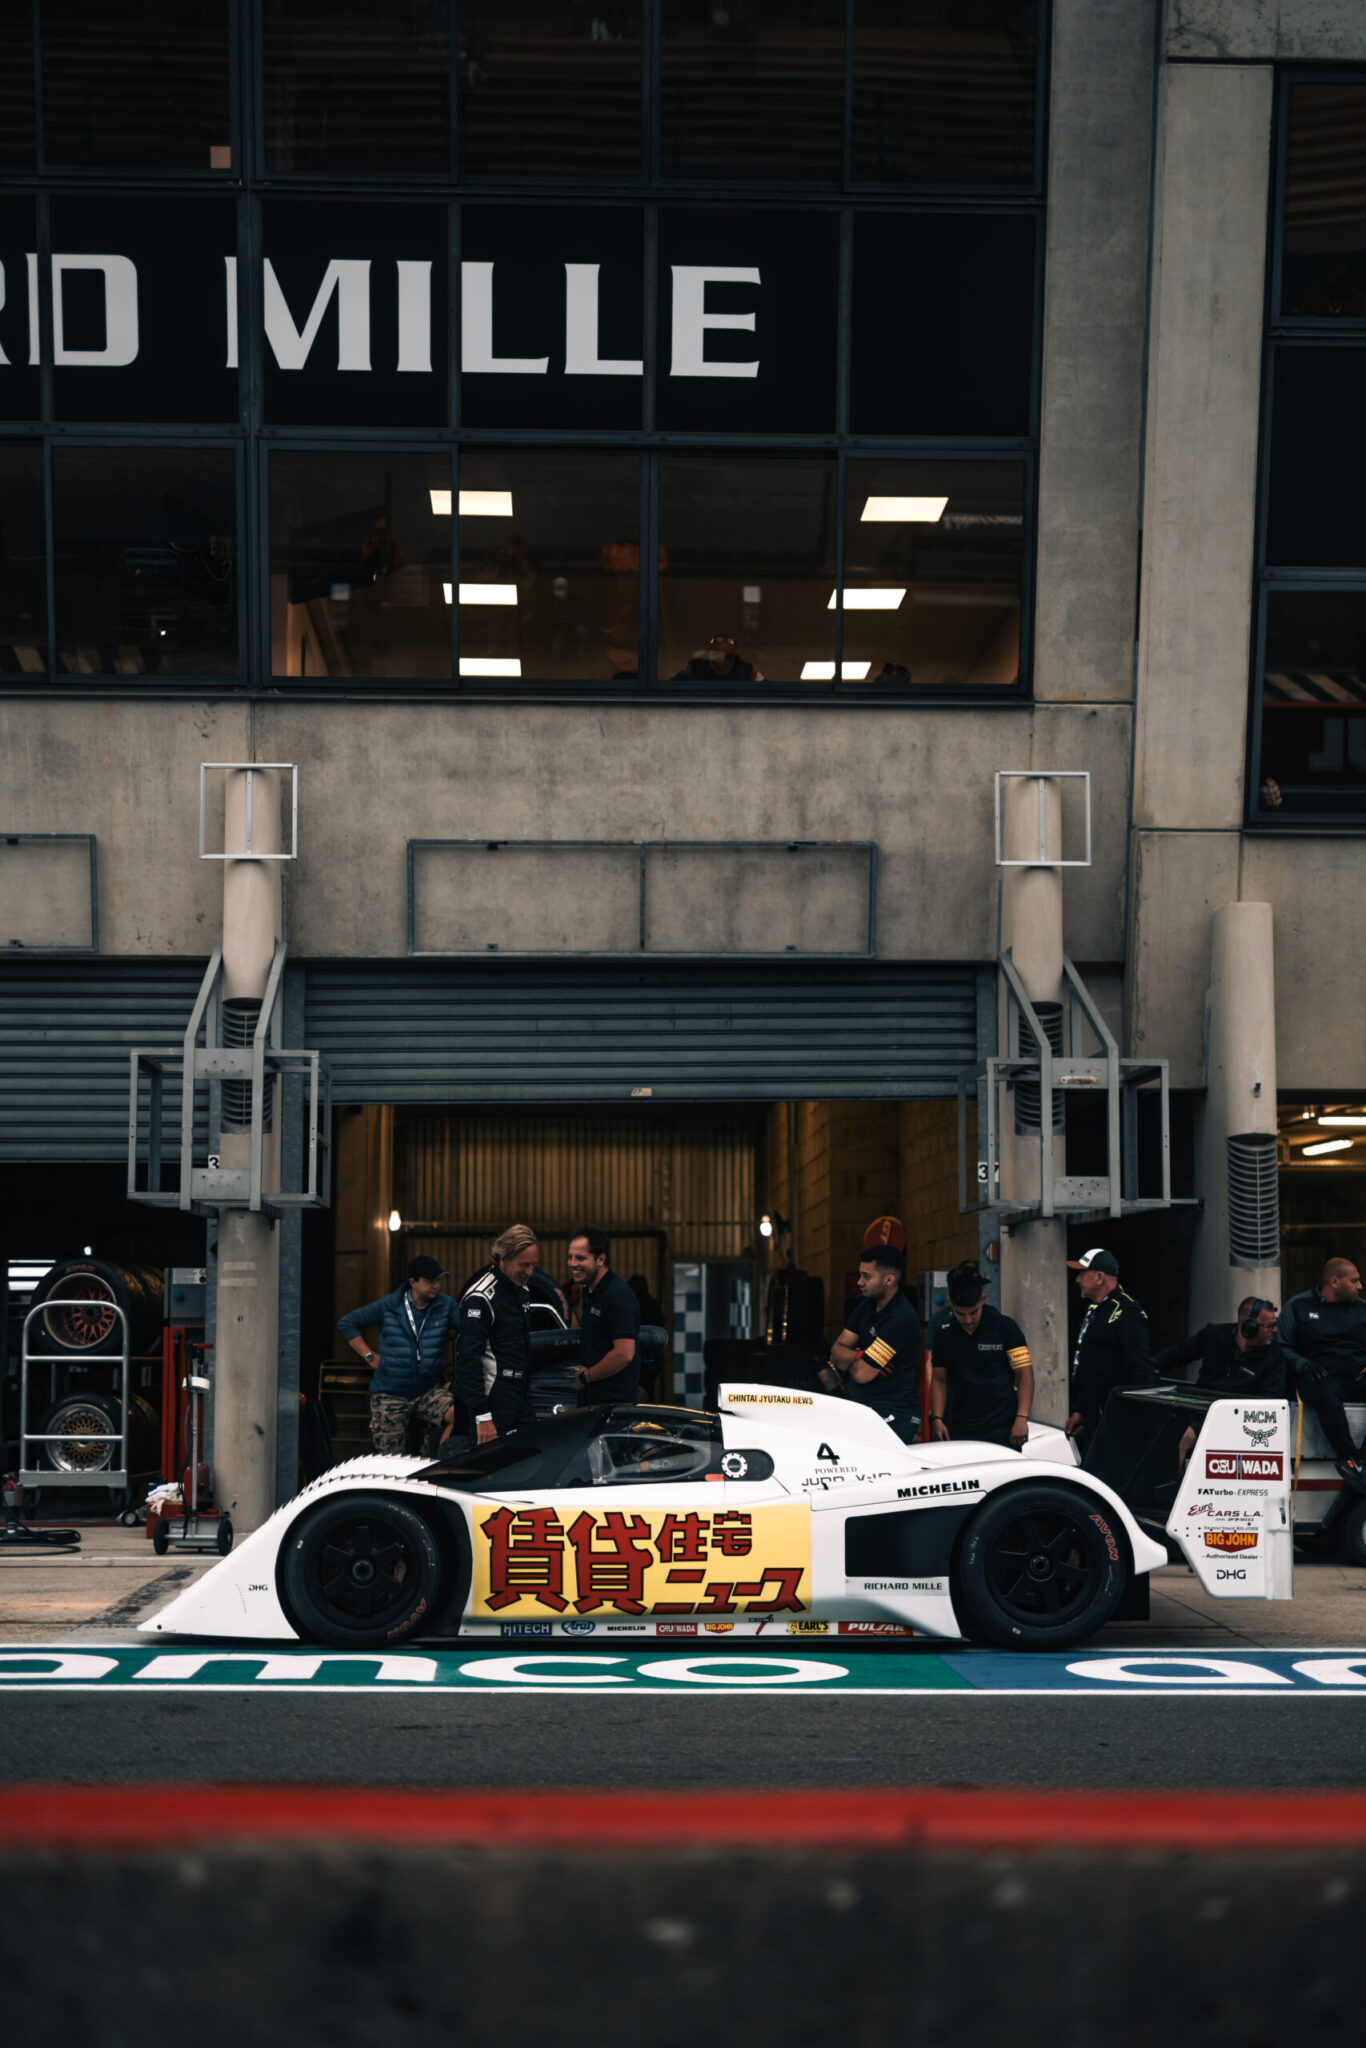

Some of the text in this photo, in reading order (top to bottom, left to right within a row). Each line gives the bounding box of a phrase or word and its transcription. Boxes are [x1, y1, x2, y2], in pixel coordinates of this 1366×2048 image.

[0, 252, 761, 378] D MILLE
[728, 1394, 813, 1405] CHINTAI JYUTAKU NEWS
[1243, 1410, 1277, 1424] MCM
[816, 1442, 840, 1466] 4
[814, 1466, 858, 1475] POWERED
[1242, 1460, 1280, 1475] WADA
[897, 1479, 980, 1499] MICHELIN
[1088, 1513, 1118, 1561] AVON
[1206, 1533, 1255, 1546] BIG JOHN
[1216, 1569, 1247, 1580] DHG
[864, 1582, 943, 1590] RICHARD MILLE
[799, 1621, 829, 1631] EARL'S
